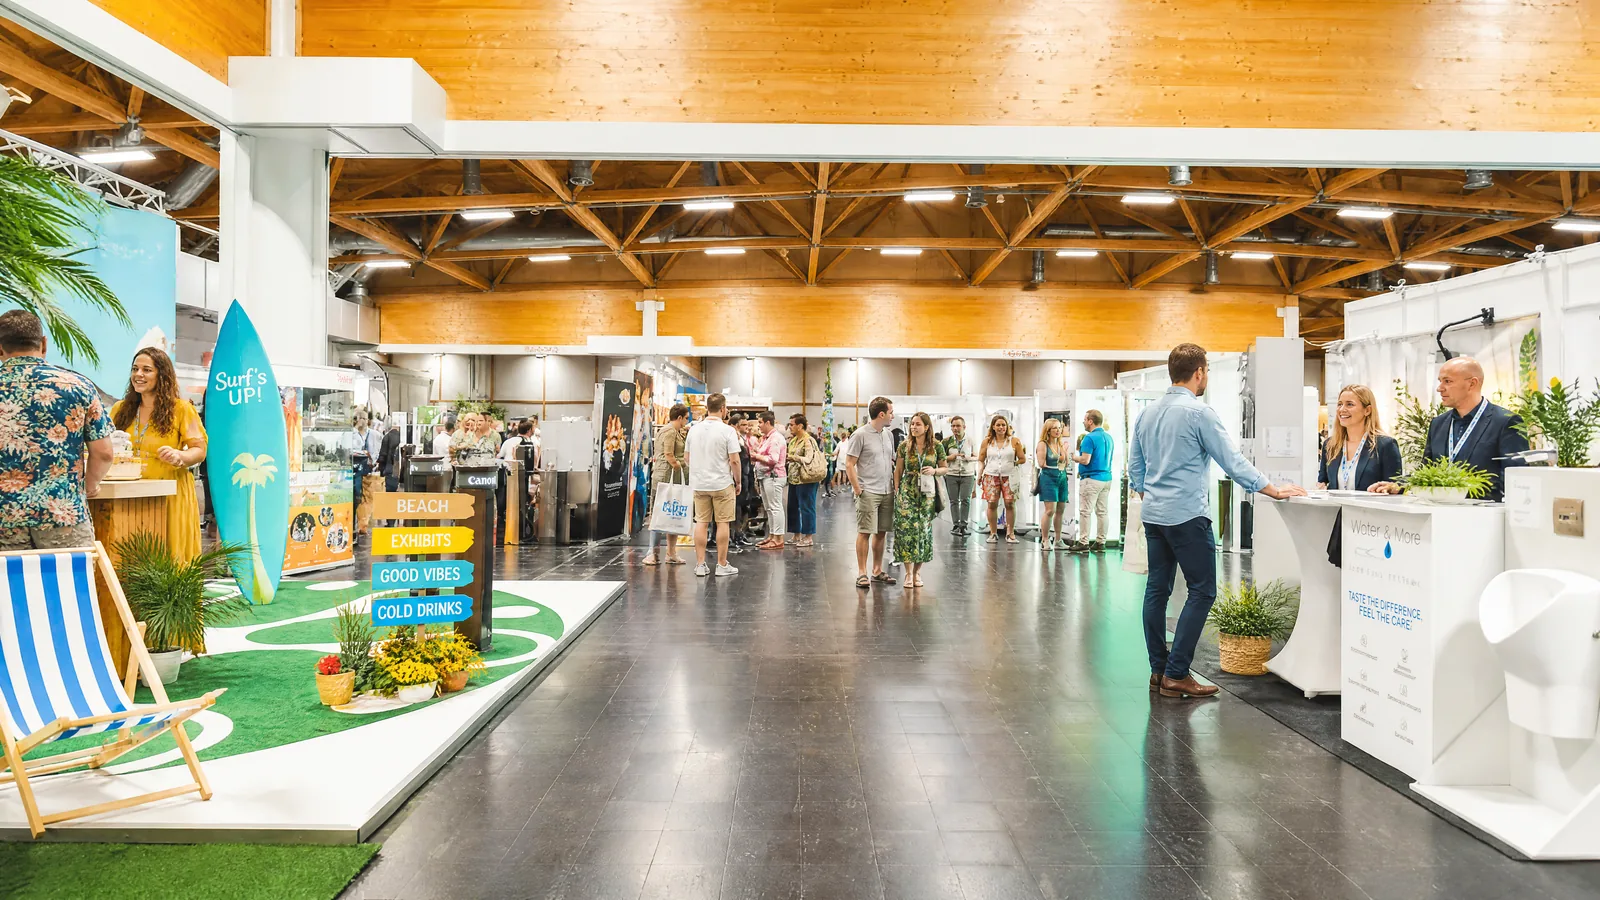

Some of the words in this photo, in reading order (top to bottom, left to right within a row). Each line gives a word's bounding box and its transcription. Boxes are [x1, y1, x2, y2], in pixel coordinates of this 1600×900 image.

[215, 367, 267, 391] Surf's
[229, 386, 262, 405] UP!
[397, 499, 449, 513] BEACH
[391, 533, 451, 548] EXHIBITS
[1350, 519, 1381, 538] Water
[1383, 525, 1391, 540] &
[1394, 527, 1421, 546] More
[380, 568, 419, 583] GOOD
[423, 567, 461, 581] VIBES
[1348, 590, 1366, 605] TASTE
[1367, 595, 1379, 608] THE
[377, 603, 413, 620] COLD
[417, 601, 463, 617] DRINKS
[1359, 605, 1375, 620] FEEL
[1376, 610, 1390, 624] THE
